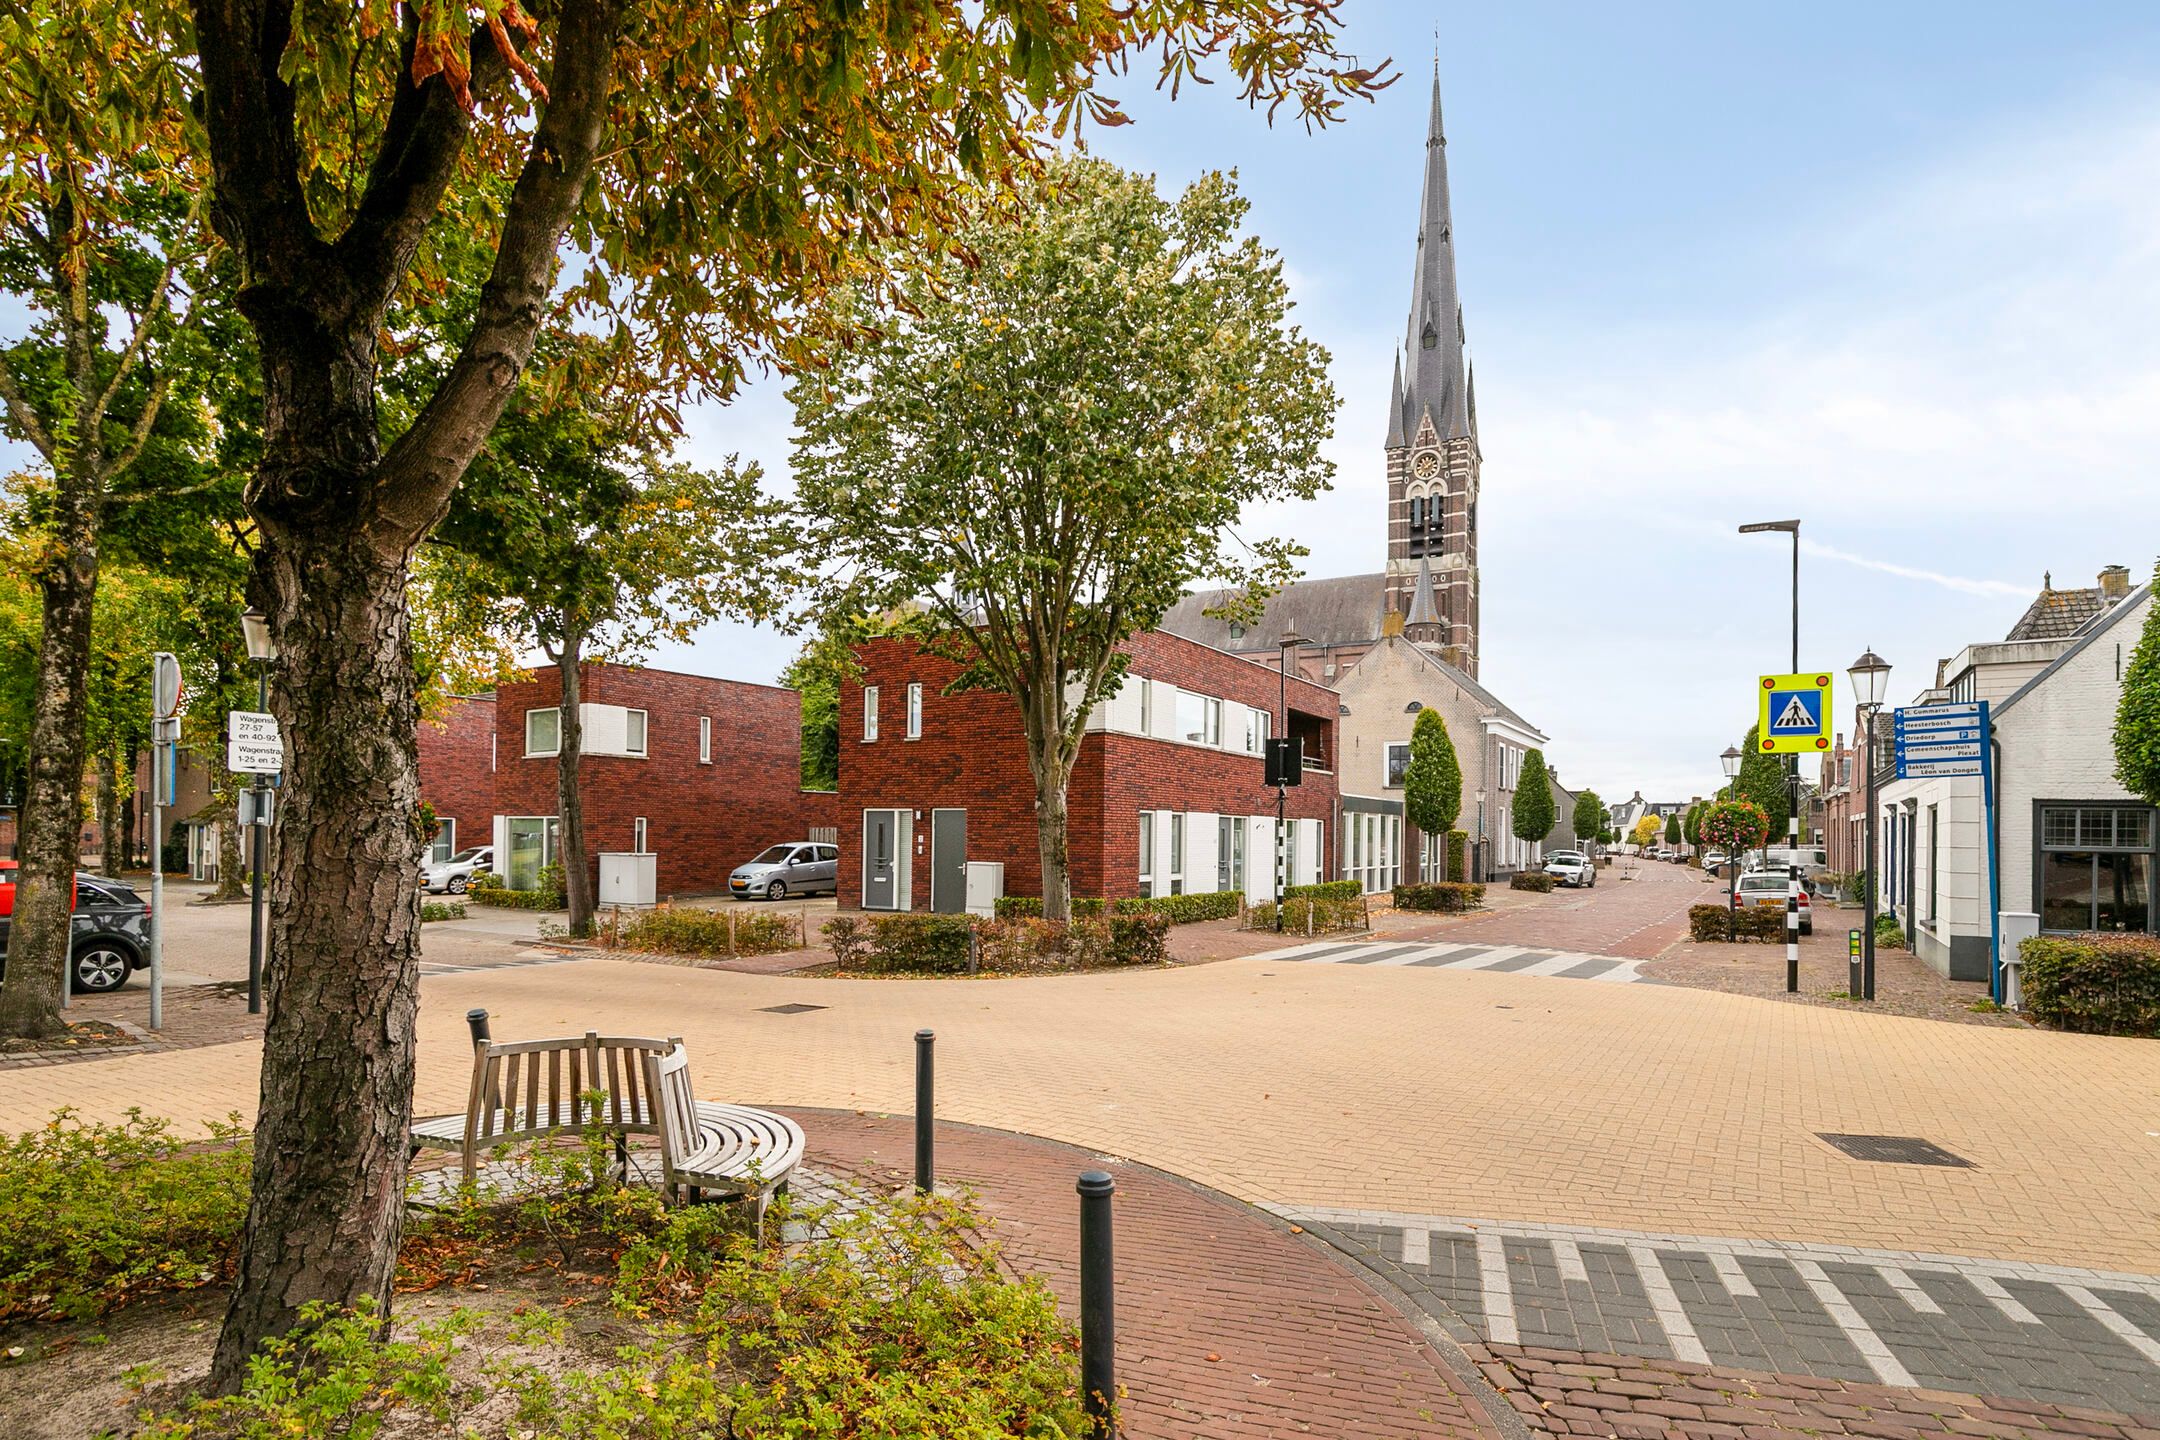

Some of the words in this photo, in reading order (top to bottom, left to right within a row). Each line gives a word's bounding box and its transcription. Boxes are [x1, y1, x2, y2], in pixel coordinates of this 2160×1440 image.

[239, 715, 277, 724] Wagenstr
[239, 724, 263, 732] 27-57
[1905, 720, 1952, 728] Heesterbosch
[251, 734, 277, 742] 40-92
[238, 745, 282, 754] Wagenstra
[1906, 744, 1971, 753] Gemeenschapshuis
